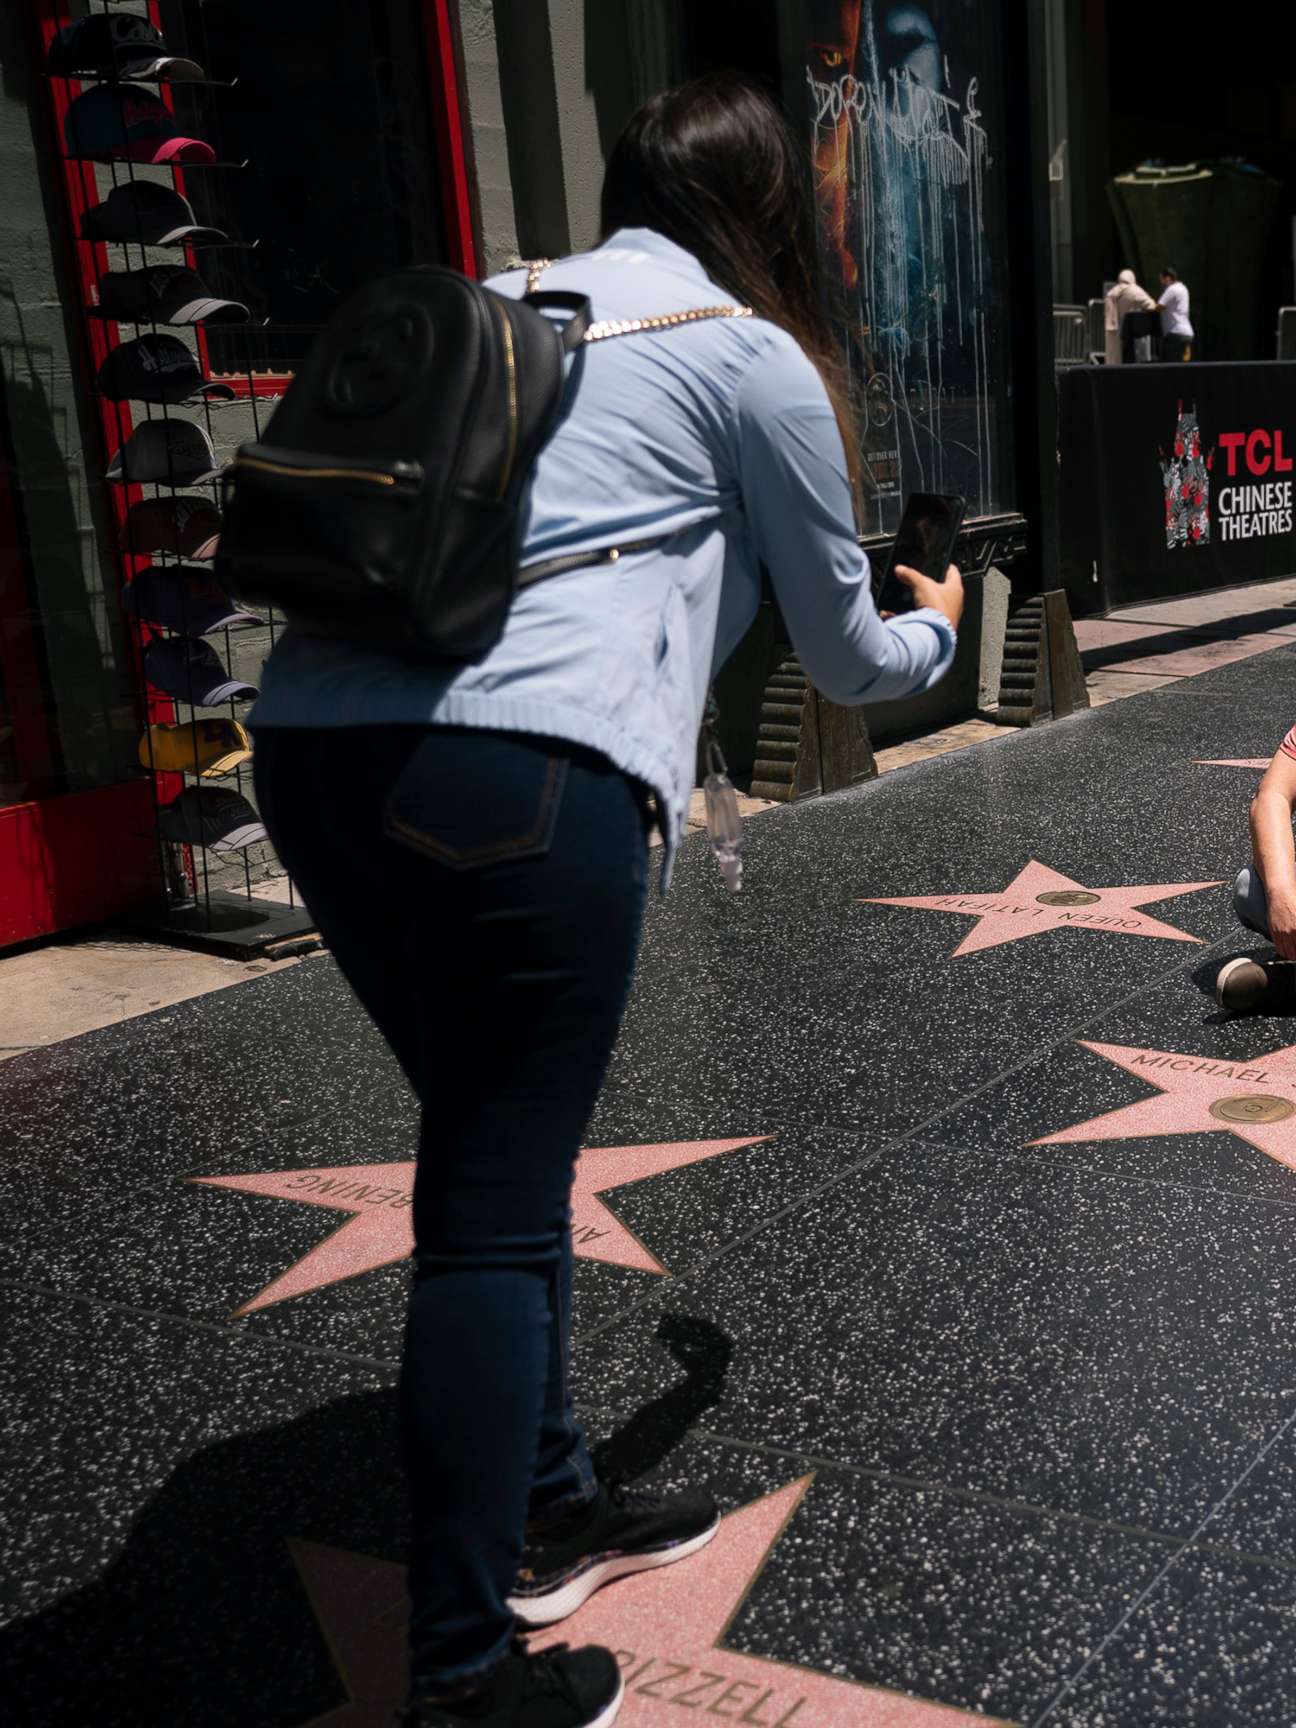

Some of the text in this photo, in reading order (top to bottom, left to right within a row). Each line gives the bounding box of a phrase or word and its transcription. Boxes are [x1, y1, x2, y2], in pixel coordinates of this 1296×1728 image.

[1218, 428, 1293, 476] TCL
[1217, 480, 1292, 516] CHINESE
[1218, 508, 1292, 542] THEATRES
[935, 898, 1142, 930] QUEEN LATIFAH
[1130, 1054, 1270, 1084] MICHAEL
